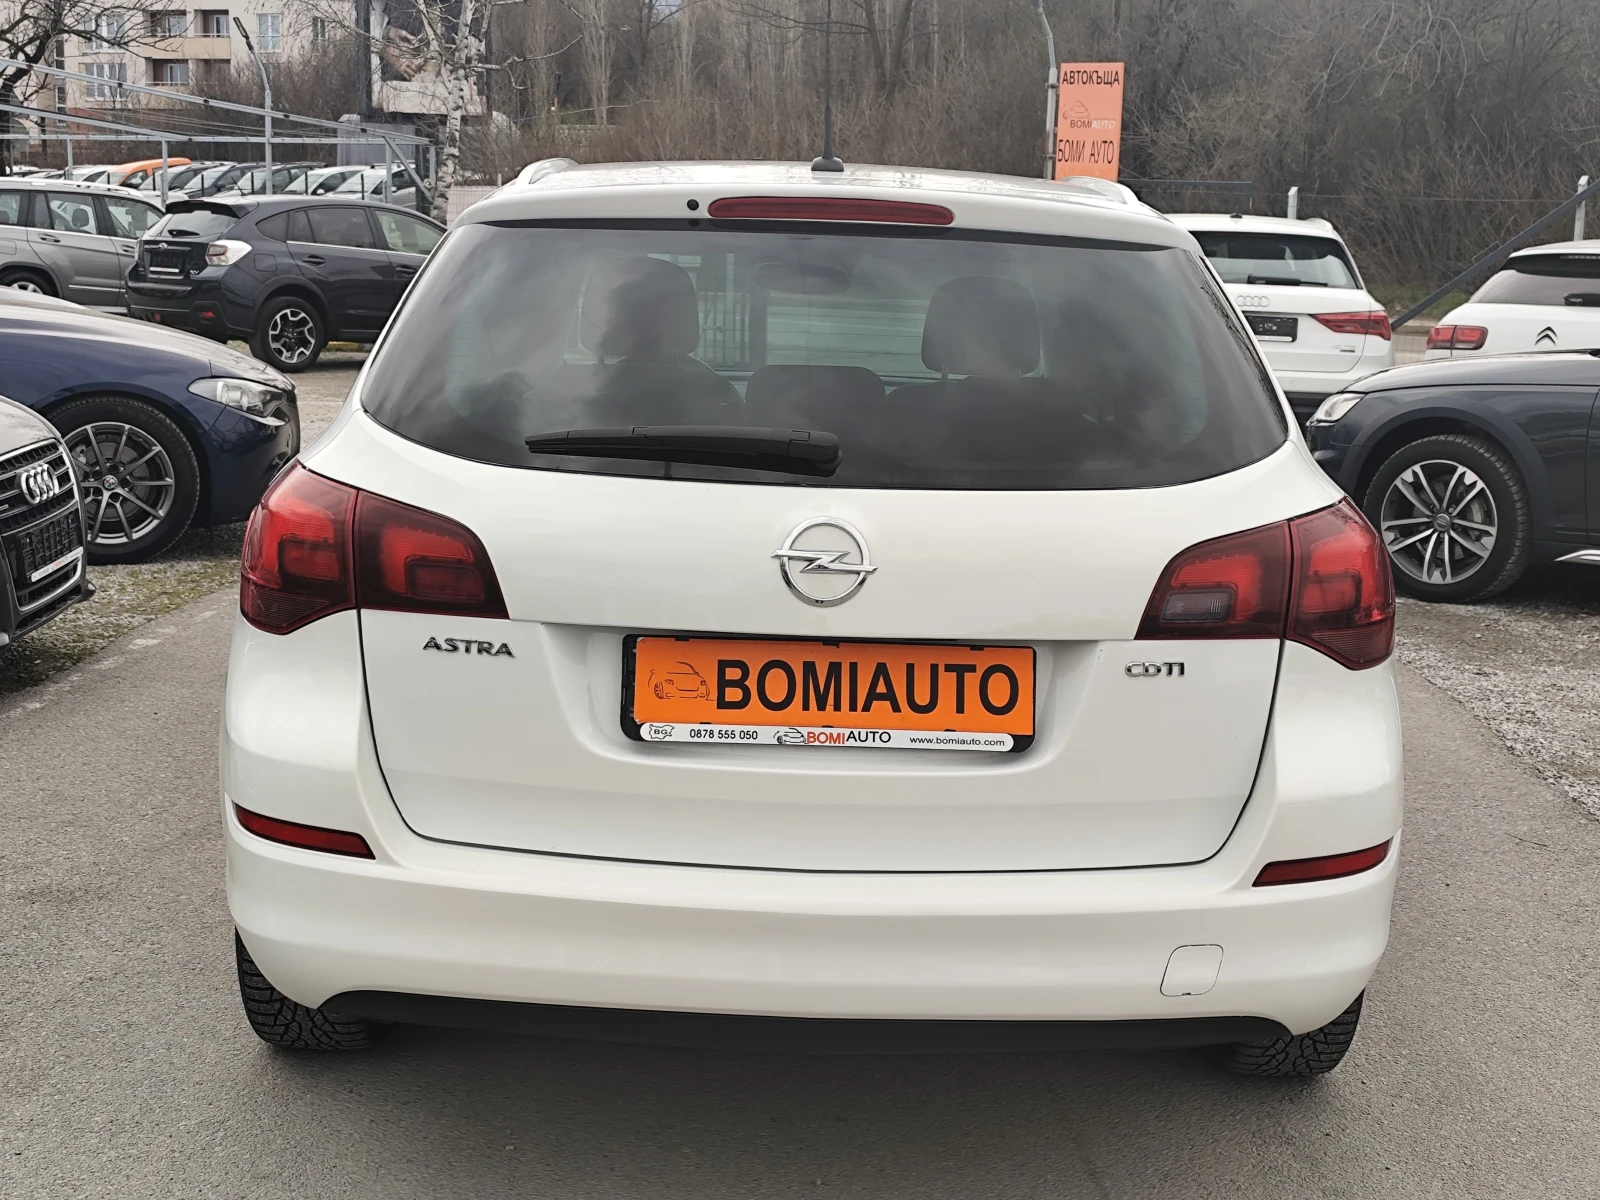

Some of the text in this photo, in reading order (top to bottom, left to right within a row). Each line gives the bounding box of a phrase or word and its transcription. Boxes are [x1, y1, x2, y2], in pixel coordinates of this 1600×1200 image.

[1062, 70, 1120, 88] АВТОКЪЩА
[1070, 119, 1116, 129] BOMIAUTO
[1057, 139, 1115, 164] БОМИ АУТО
[422, 636, 516, 658] ASTRA
[1125, 661, 1185, 677] CDTI
[716, 659, 1019, 716] BOMIAUTO
[653, 728, 1005, 747] BG 0878 555 050 BOMIAUTO www.bomiauto.com
